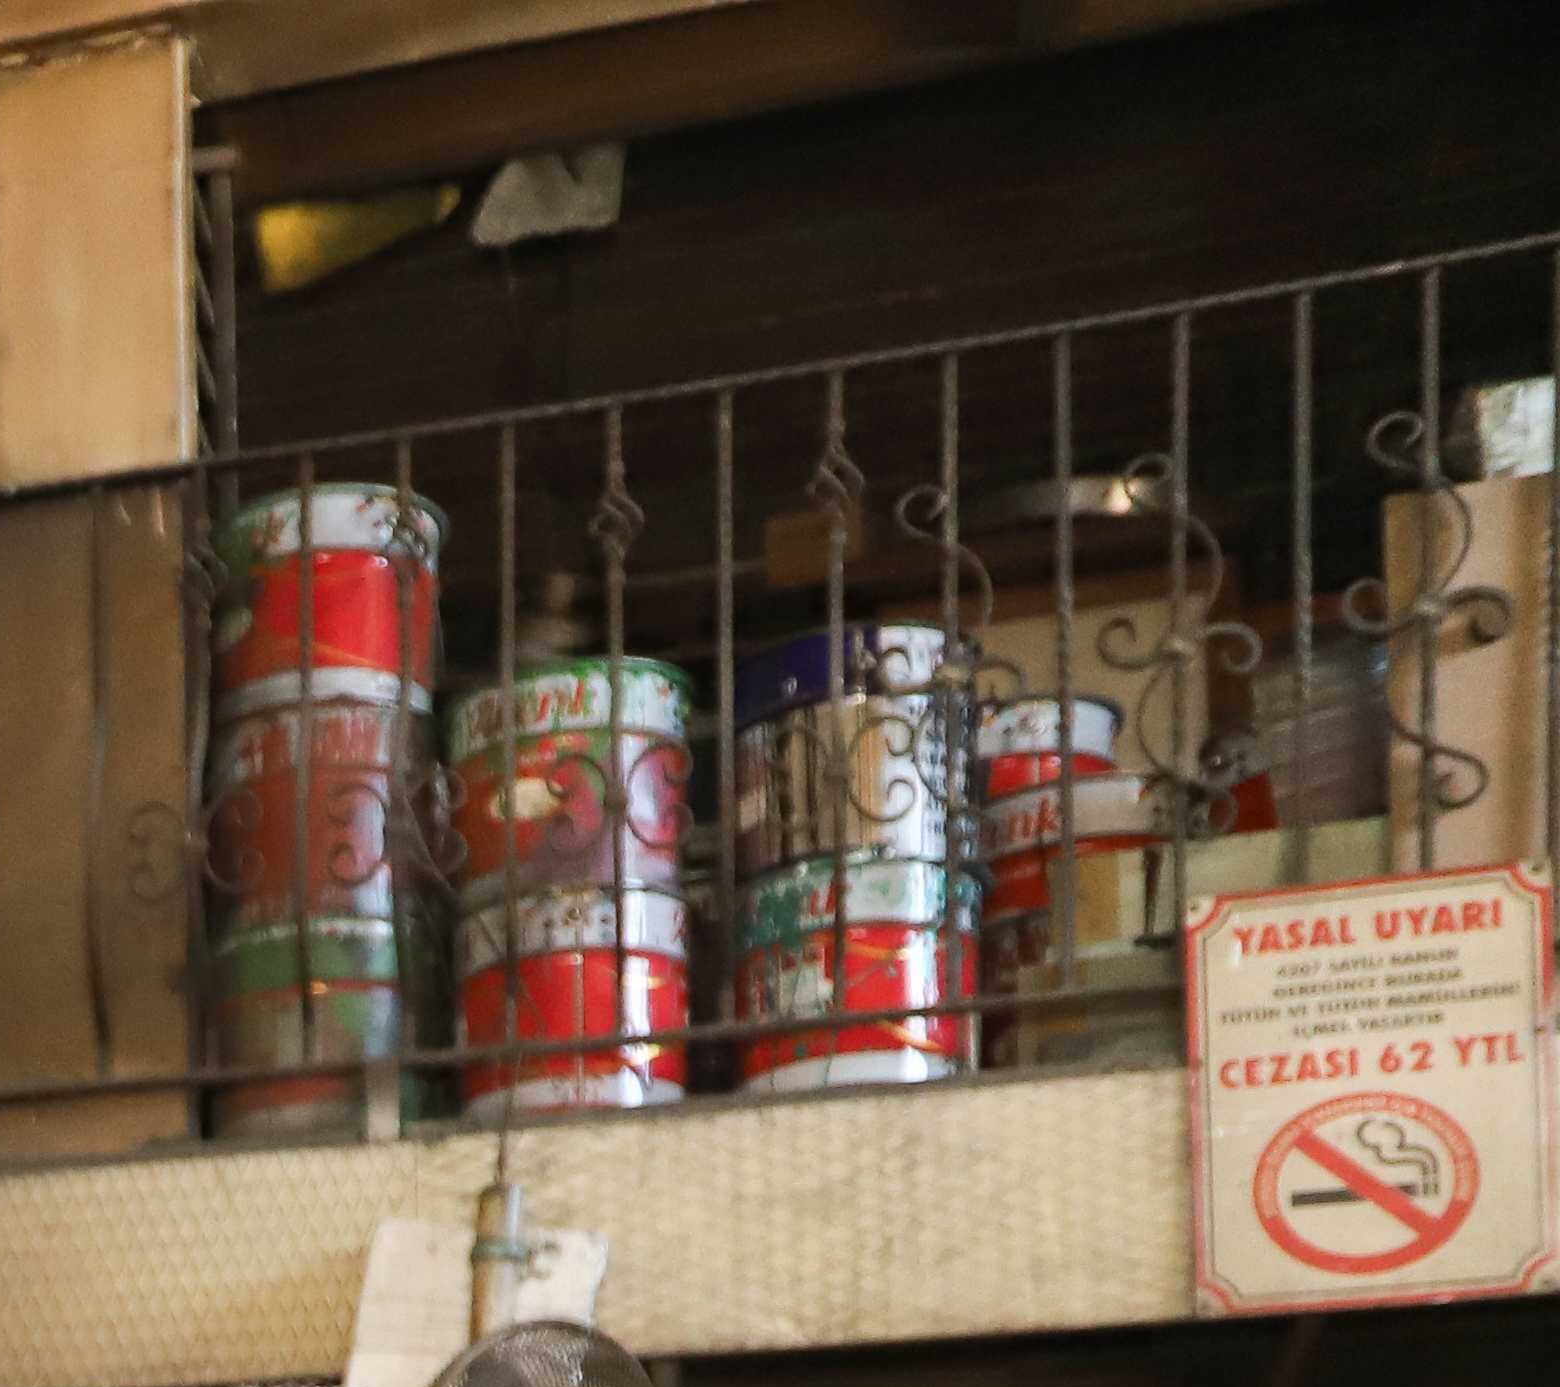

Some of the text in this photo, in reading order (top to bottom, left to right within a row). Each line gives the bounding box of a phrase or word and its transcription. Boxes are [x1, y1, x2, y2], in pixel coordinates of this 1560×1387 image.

[1233, 898, 1503, 956] YASAL UYARI
[1220, 1031, 1526, 1090] CEZASI 62 YTL
